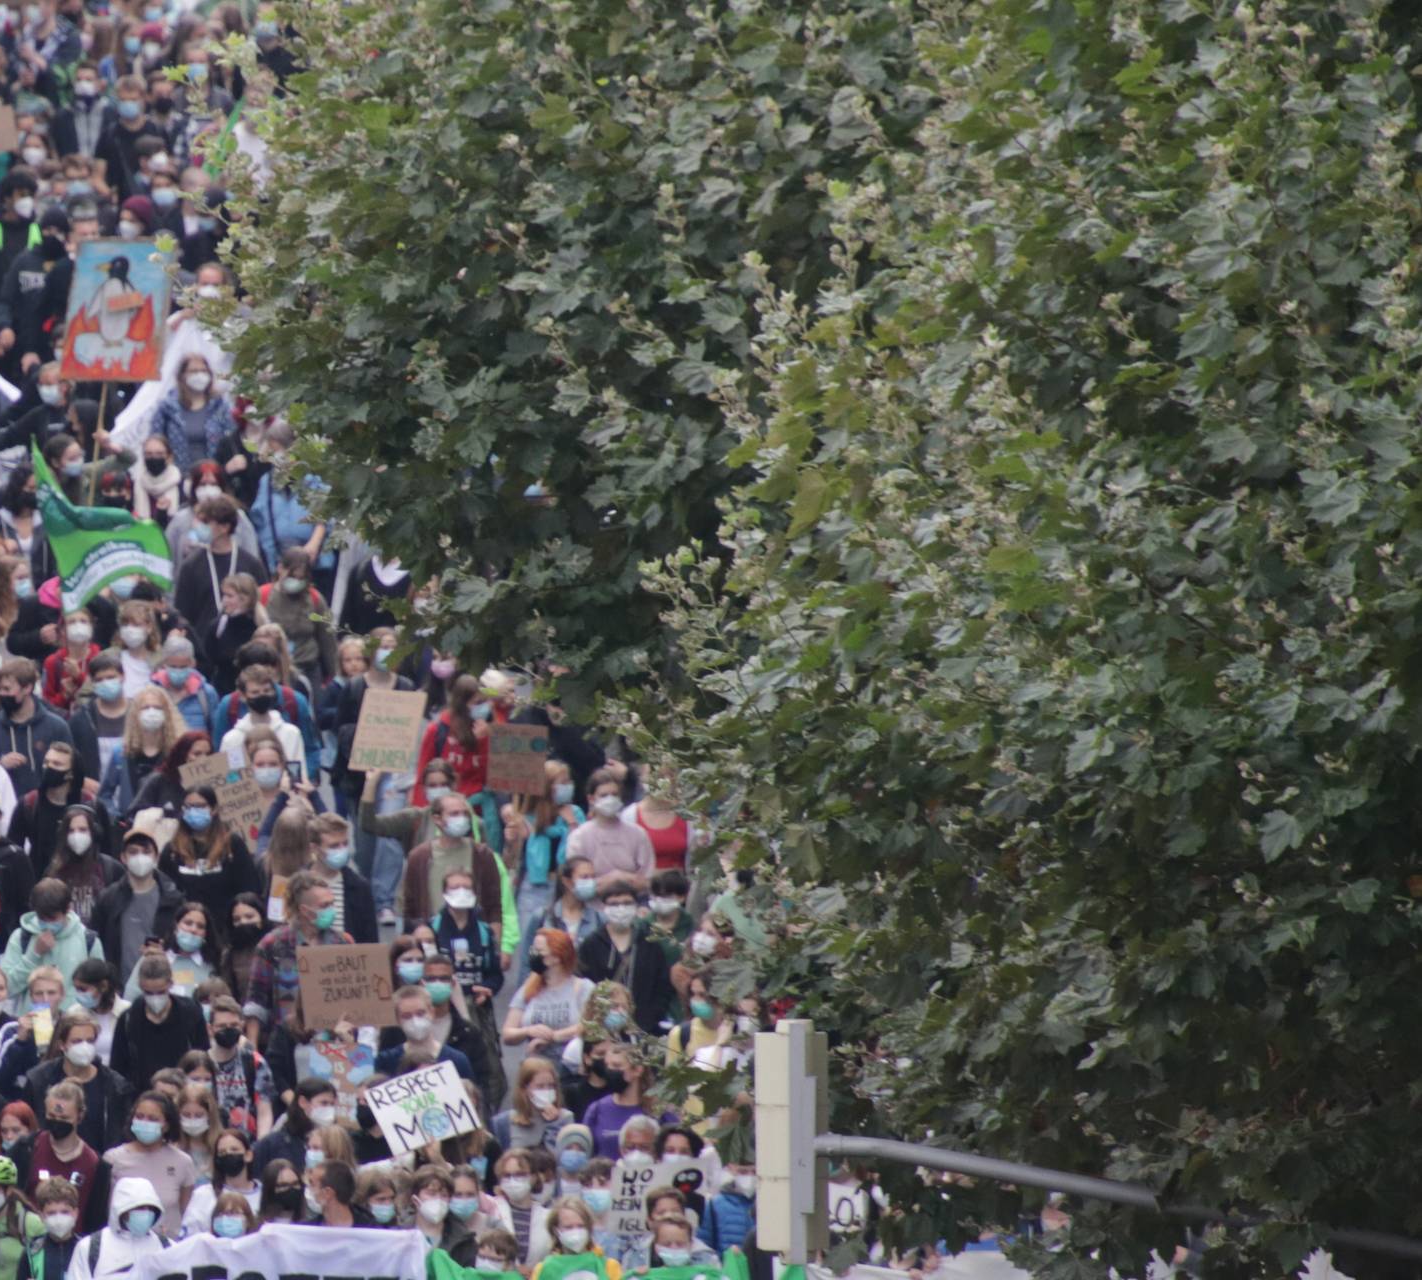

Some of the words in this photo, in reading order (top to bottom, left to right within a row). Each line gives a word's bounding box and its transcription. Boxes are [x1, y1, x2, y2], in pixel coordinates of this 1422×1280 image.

[369, 1066, 447, 1110] RESPECT
[399, 1091, 440, 1114] YOUR
[622, 1168, 654, 1184] WO
[621, 1184, 649, 1197] IST
